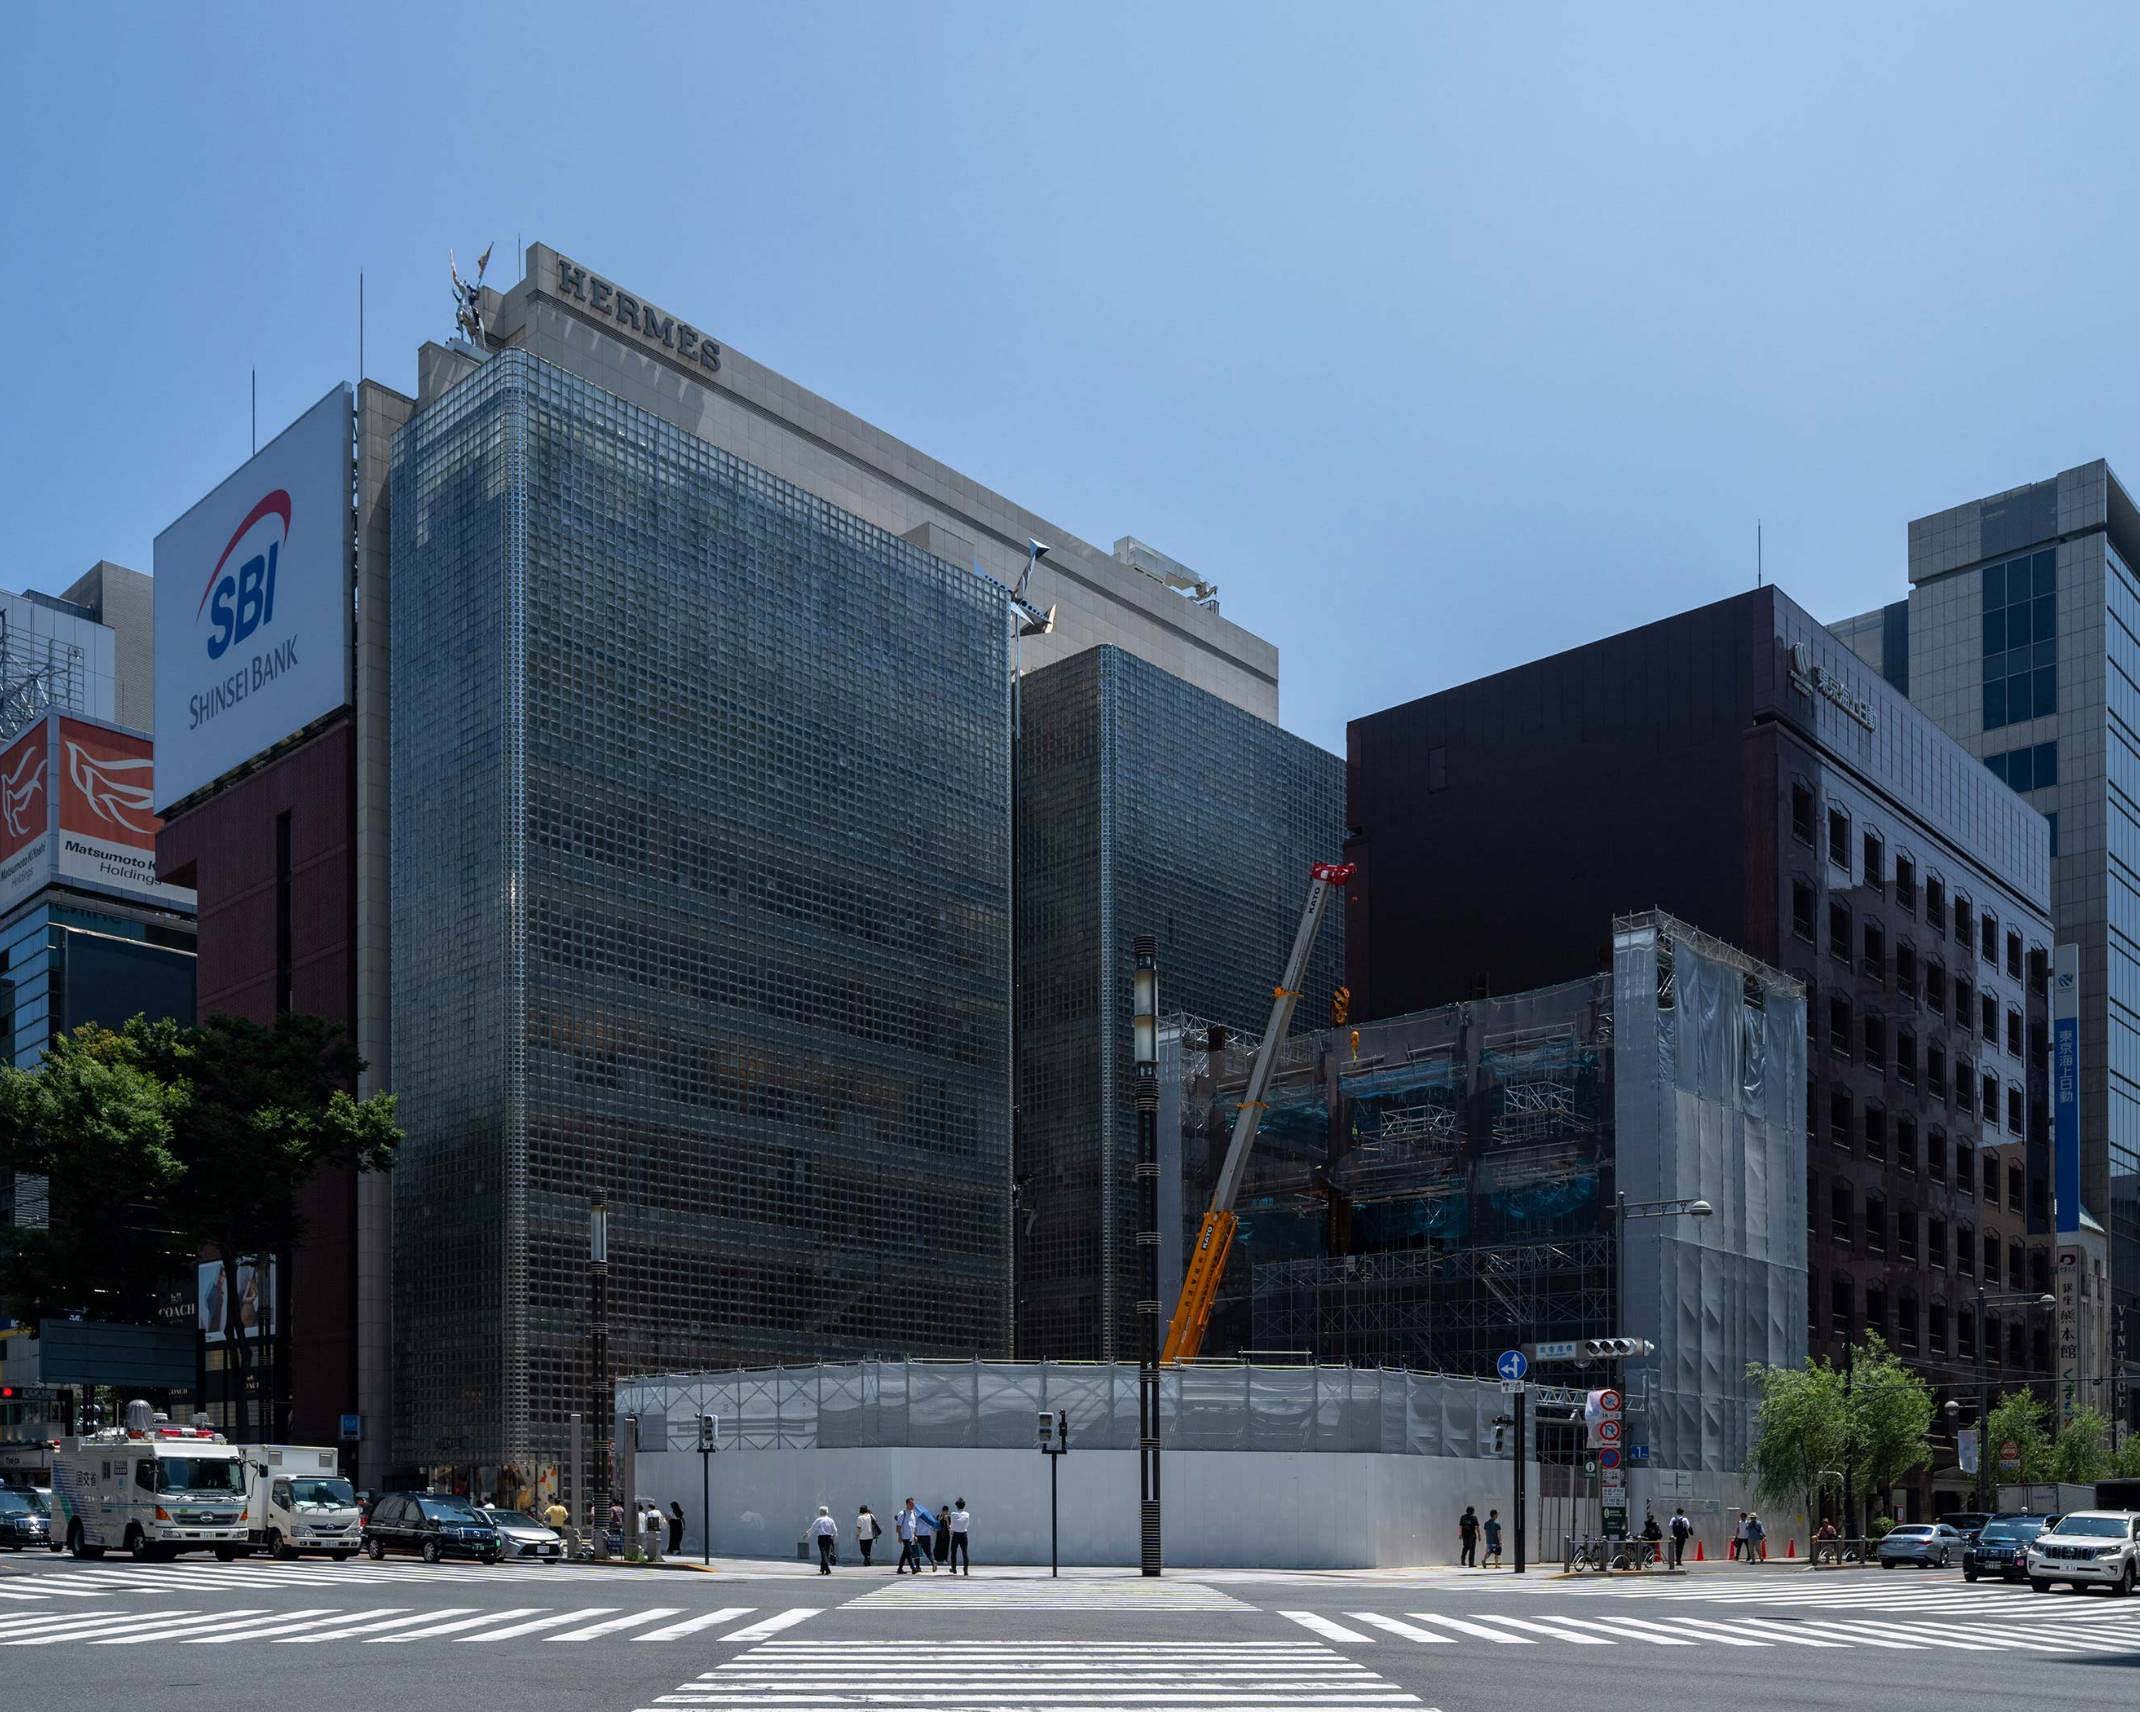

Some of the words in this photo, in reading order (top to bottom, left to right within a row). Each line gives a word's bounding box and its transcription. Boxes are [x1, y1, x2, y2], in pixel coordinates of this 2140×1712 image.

[207, 540, 279, 661] SBI
[189, 667, 249, 731] SHINSEI
[251, 633, 299, 693] BANK
[64, 840, 146, 869] Matsumoto
[1308, 887, 1321, 915] KATO
[2058, 1029, 2074, 1104] 東京海上日動
[1202, 1225, 1214, 1250] KATO
[2116, 1303, 2128, 1409] VINTAGE
